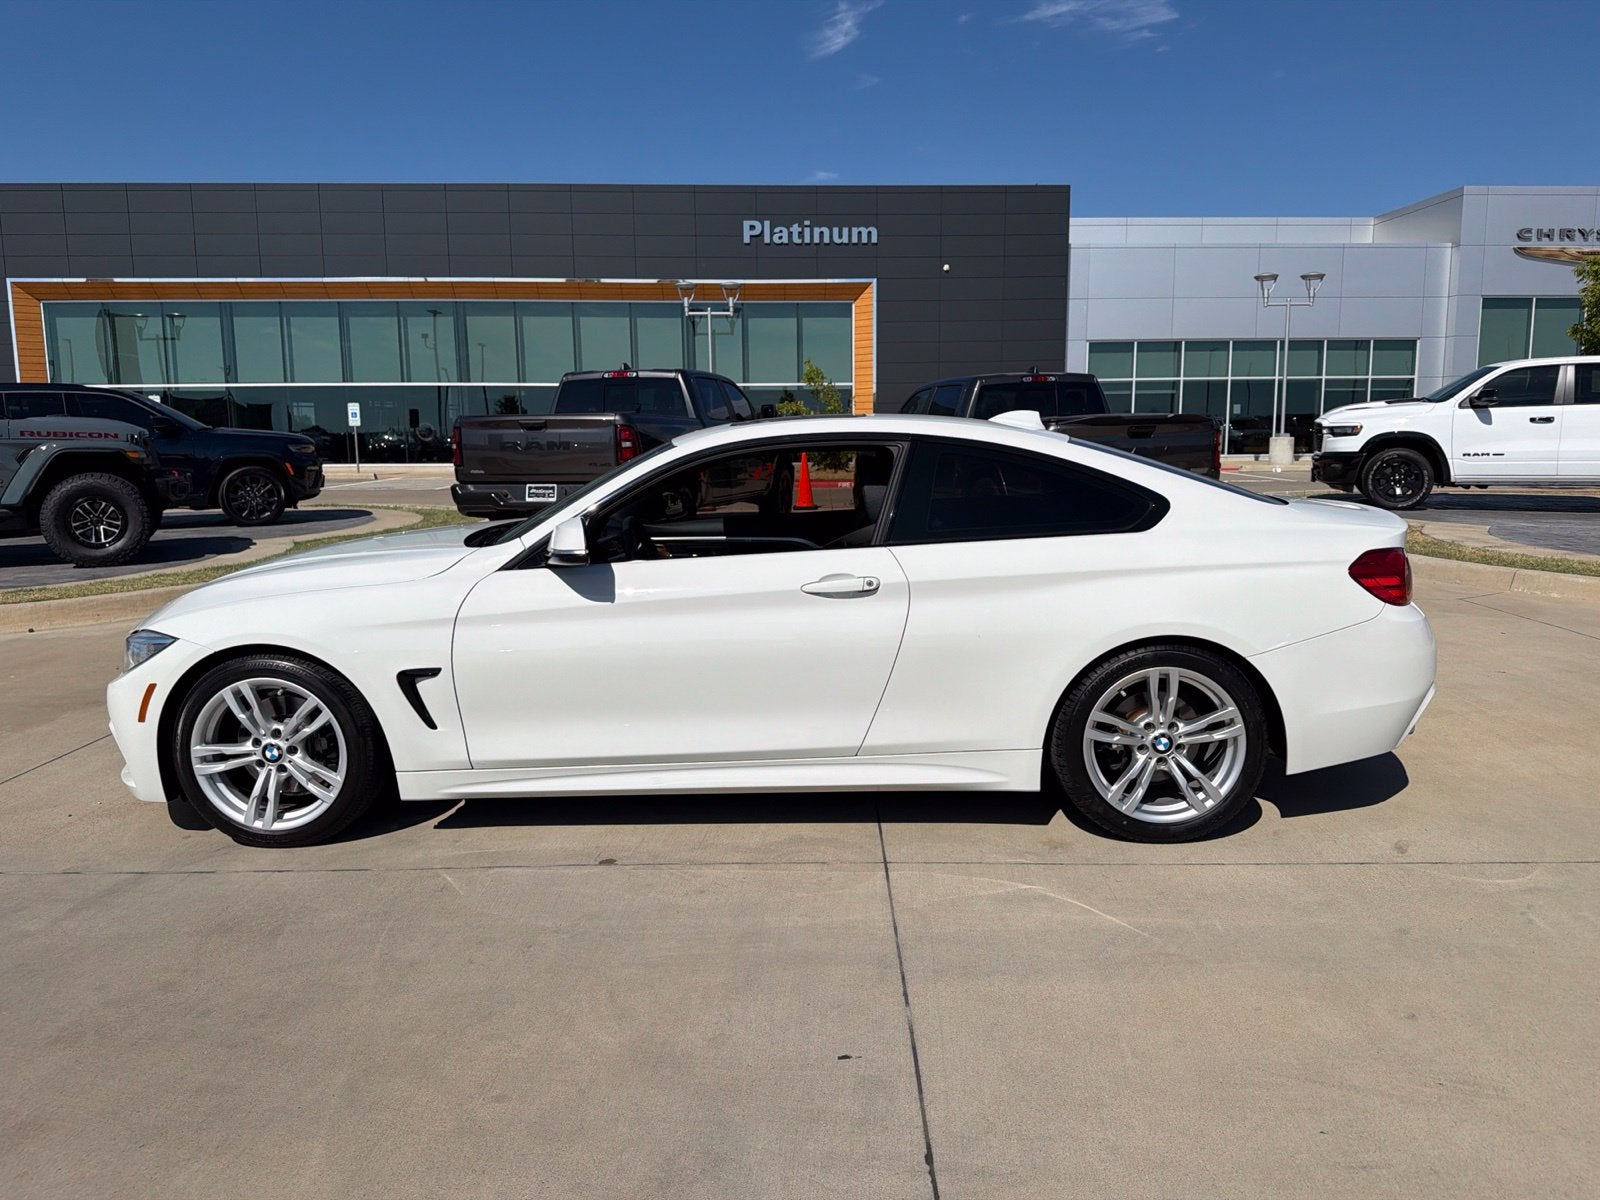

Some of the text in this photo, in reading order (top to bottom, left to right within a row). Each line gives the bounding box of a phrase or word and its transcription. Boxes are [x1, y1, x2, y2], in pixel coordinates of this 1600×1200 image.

[742, 220, 878, 245] Platinum
[1516, 227, 1600, 242] CHRY
[19, 430, 119, 439] RUBICON
[499, 440, 571, 451] RAM
